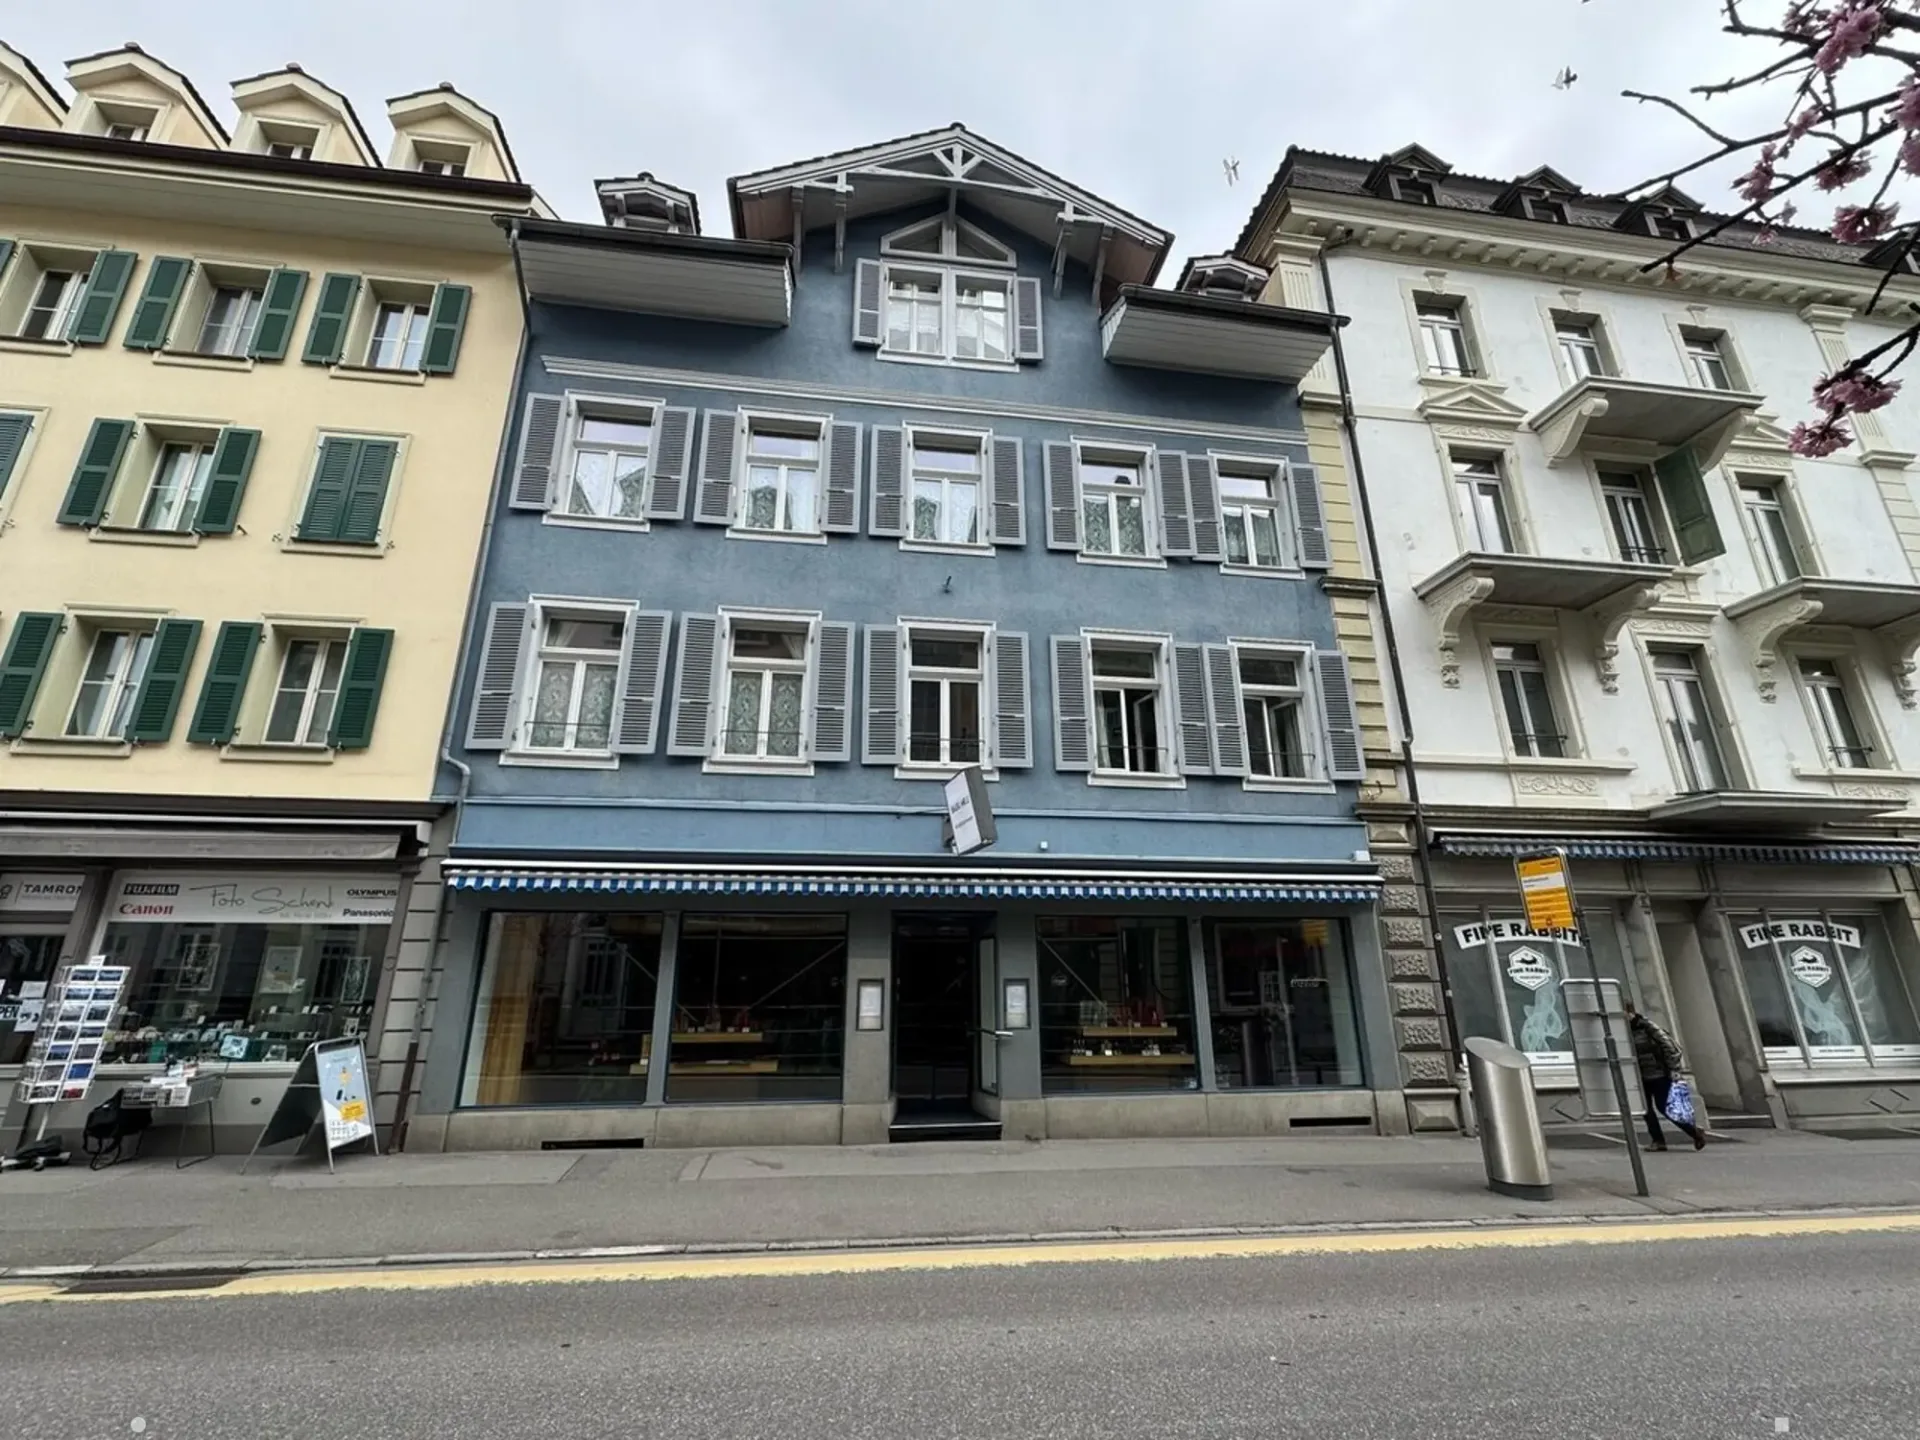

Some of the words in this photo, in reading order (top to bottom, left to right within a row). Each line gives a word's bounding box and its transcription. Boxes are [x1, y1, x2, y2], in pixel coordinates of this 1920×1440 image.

[346, 889, 397, 897] OLYMPUS
[119, 903, 174, 915] Canon
[342, 908, 395, 917] Panasonic
